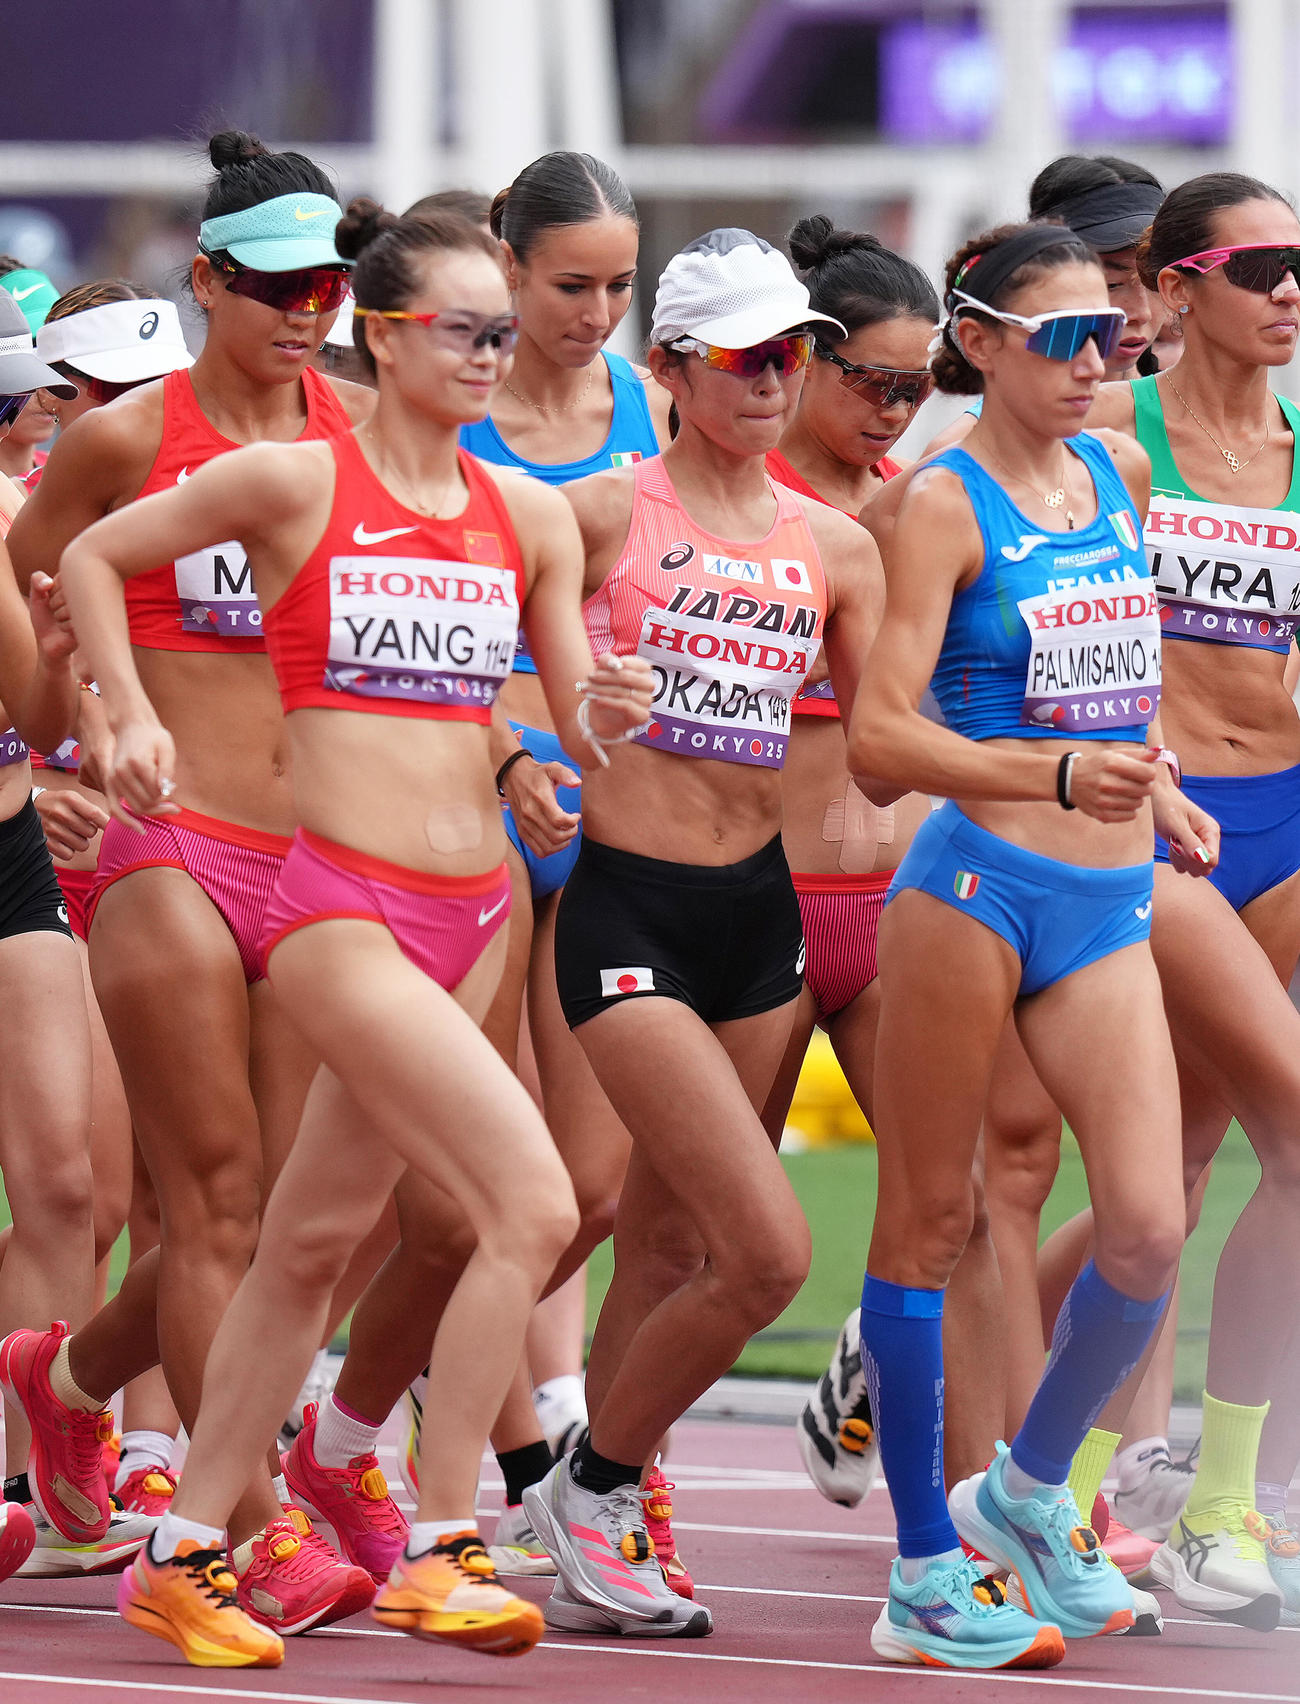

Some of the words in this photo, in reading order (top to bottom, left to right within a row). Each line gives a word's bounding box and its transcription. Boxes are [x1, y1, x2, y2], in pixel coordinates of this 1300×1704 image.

[1146, 511, 1300, 551] HOND
[337, 572, 513, 608] HONDA
[708, 558, 758, 580] ACN
[1151, 553, 1276, 608] LYRA
[667, 586, 817, 639] JAPAN
[1032, 592, 1160, 630] HONDA
[345, 617, 474, 665] YANG
[644, 622, 807, 674] HONDA
[1033, 639, 1146, 692] PALMISANO
